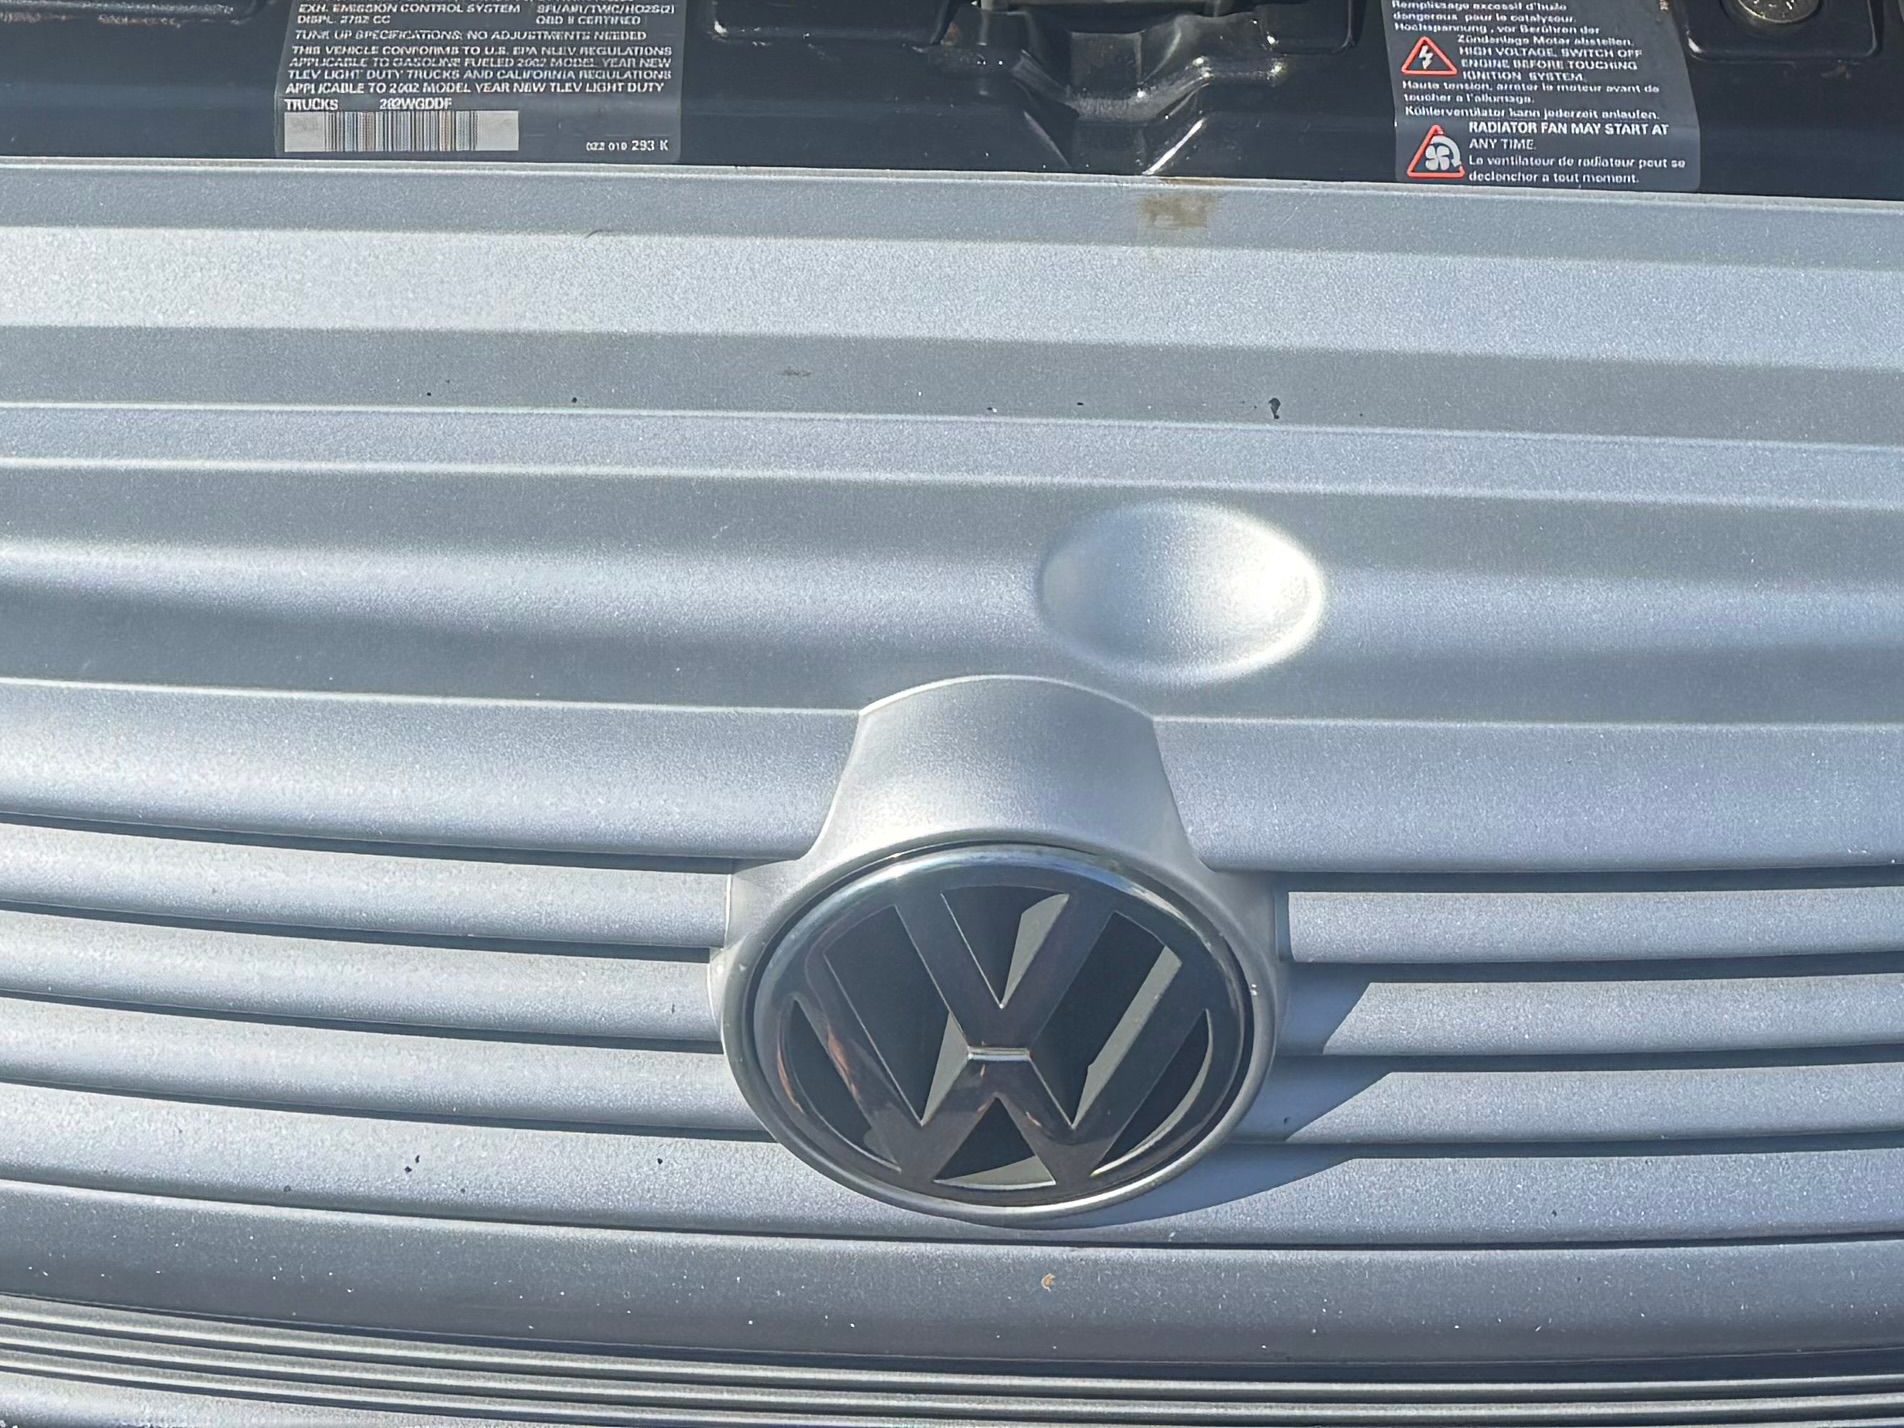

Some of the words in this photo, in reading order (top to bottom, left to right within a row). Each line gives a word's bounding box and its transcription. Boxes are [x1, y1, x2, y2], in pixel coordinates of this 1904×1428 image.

[400, 4, 463, 13] CONTROL
[334, 30, 352, 39] UP
[467, 30, 488, 40] NO
[491, 31, 590, 40] ADJUSTMENTS
[325, 46, 379, 55] VEHICLE
[463, 46, 480, 55] TO
[579, 46, 672, 56] REGULATIONS
[1459, 46, 1492, 56] HIGH
[1561, 48, 1614, 57] SWITCH
[1617, 49, 1643, 58] OFF
[639, 58, 672, 68] NEW
[1461, 58, 1511, 68] ENGINE
[1513, 59, 1564, 69] BEFORE
[1567, 60, 1638, 71] TOUCHING
[407, 70, 459, 80] TRUCKS
[463, 69, 494, 80] AND
[497, 70, 576, 79] CALIFORNIA
[579, 70, 672, 79] REGULATIONS
[1462, 70, 1522, 80] IGNITION
[368, 83, 386, 93] TO
[423, 83, 471, 94] MODEL
[476, 82, 511, 93] YEAR
[513, 82, 546, 92] NEW
[550, 82, 582, 92] TLEV
[585, 82, 624, 92] LIGHT
[627, 82, 664, 92] DUTY
[284, 99, 339, 111] TRUCKS
[1469, 122, 1538, 134] RADIATOR
[1540, 122, 1567, 134] FAN
[1571, 123, 1601, 135] MAY
[1604, 124, 1647, 135] START
[1651, 124, 1669, 135] AT
[631, 140, 655, 151] 293
[659, 140, 669, 151] K
[1469, 139, 1497, 150] ANY
